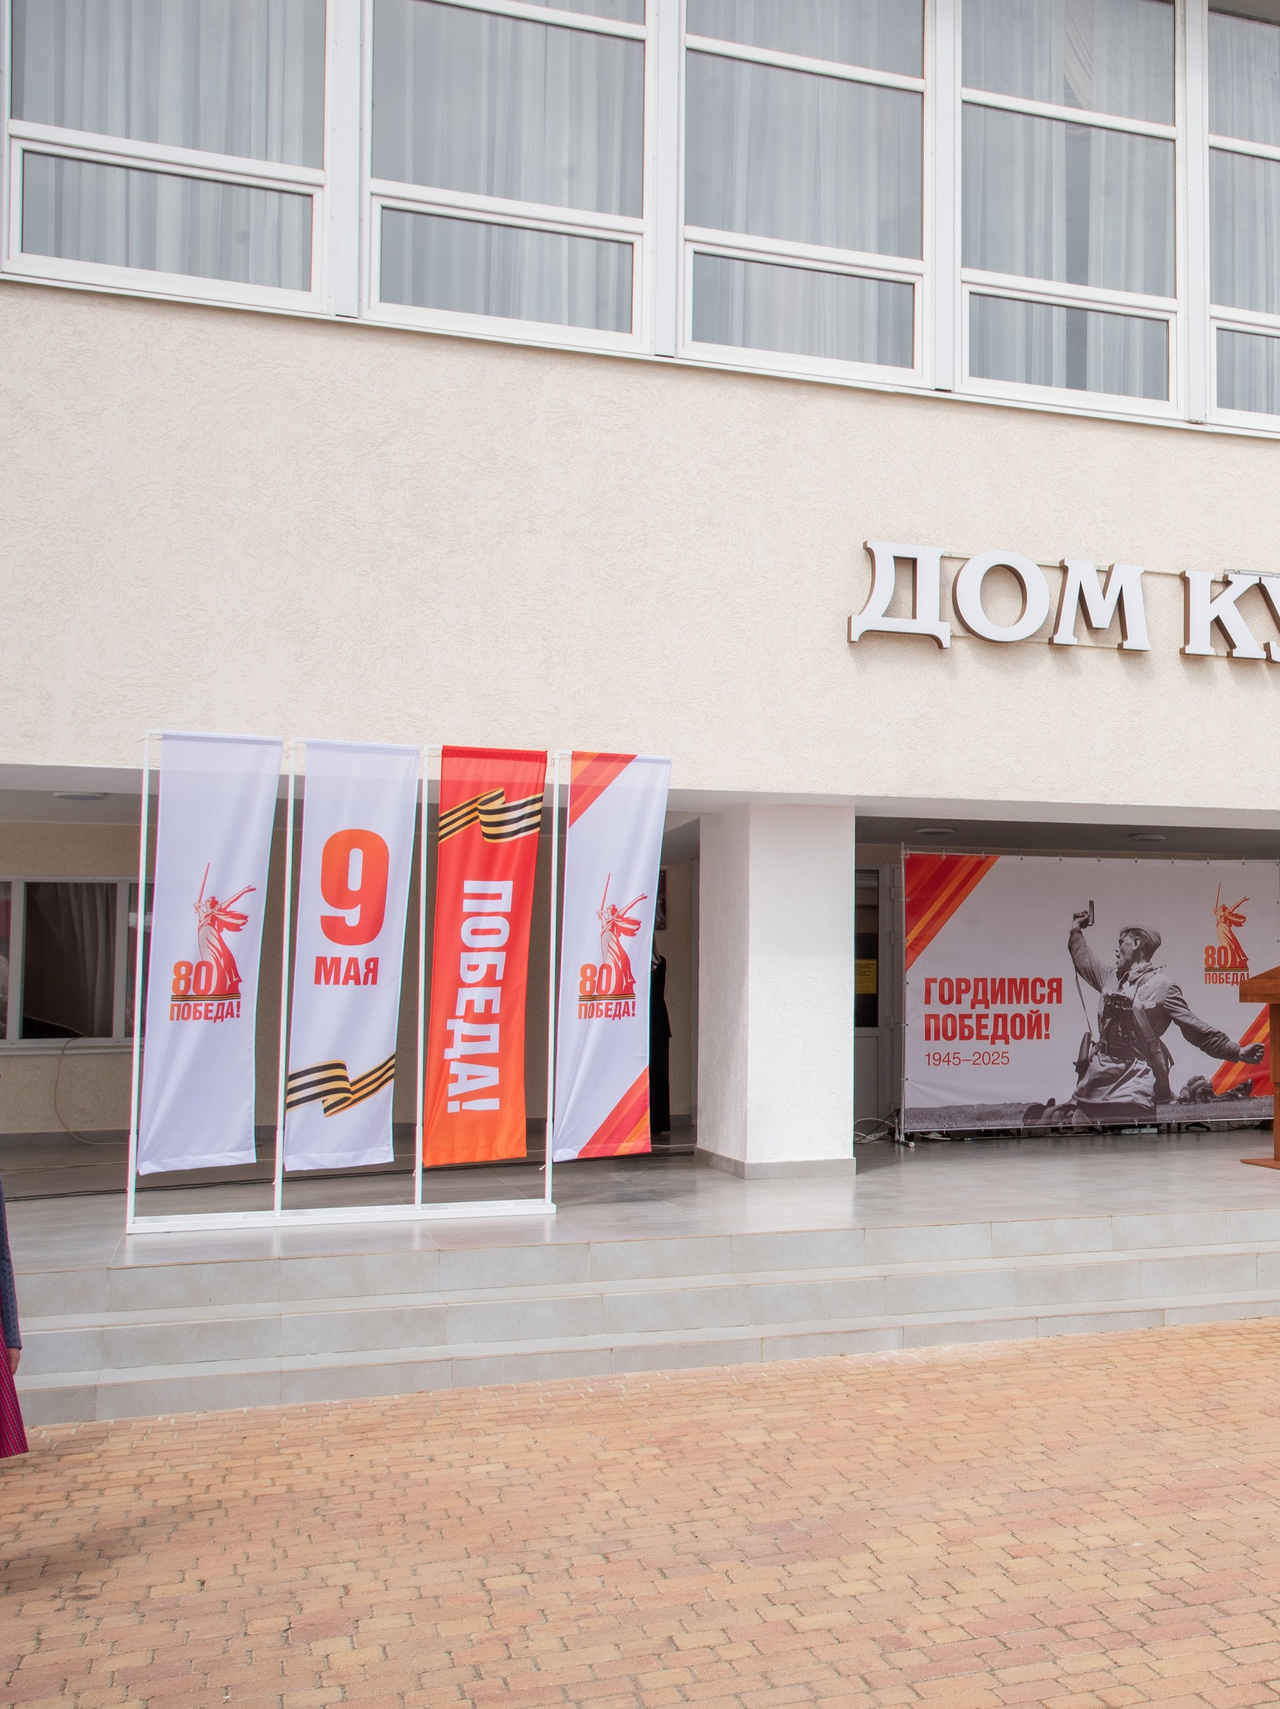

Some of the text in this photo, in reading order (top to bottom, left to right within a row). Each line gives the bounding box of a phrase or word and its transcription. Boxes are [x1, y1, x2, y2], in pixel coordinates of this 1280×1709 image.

[847, 540, 1151, 652] ДОМ
[320, 829, 390, 946] 9
[313, 956, 379, 986] МАЯ
[1204, 945, 1229, 968] 80
[172, 960, 213, 995] 80
[579, 963, 613, 995] 80
[924, 977, 1063, 1006] ГОРДИМСЯ
[169, 1001, 241, 1022] ПОБЕДА!
[443, 880, 513, 1112] ПОБЕДА!
[578, 1002, 636, 1020] ПОБЕДА!
[924, 1010, 1051, 1044] ПОБЕДОЙ!
